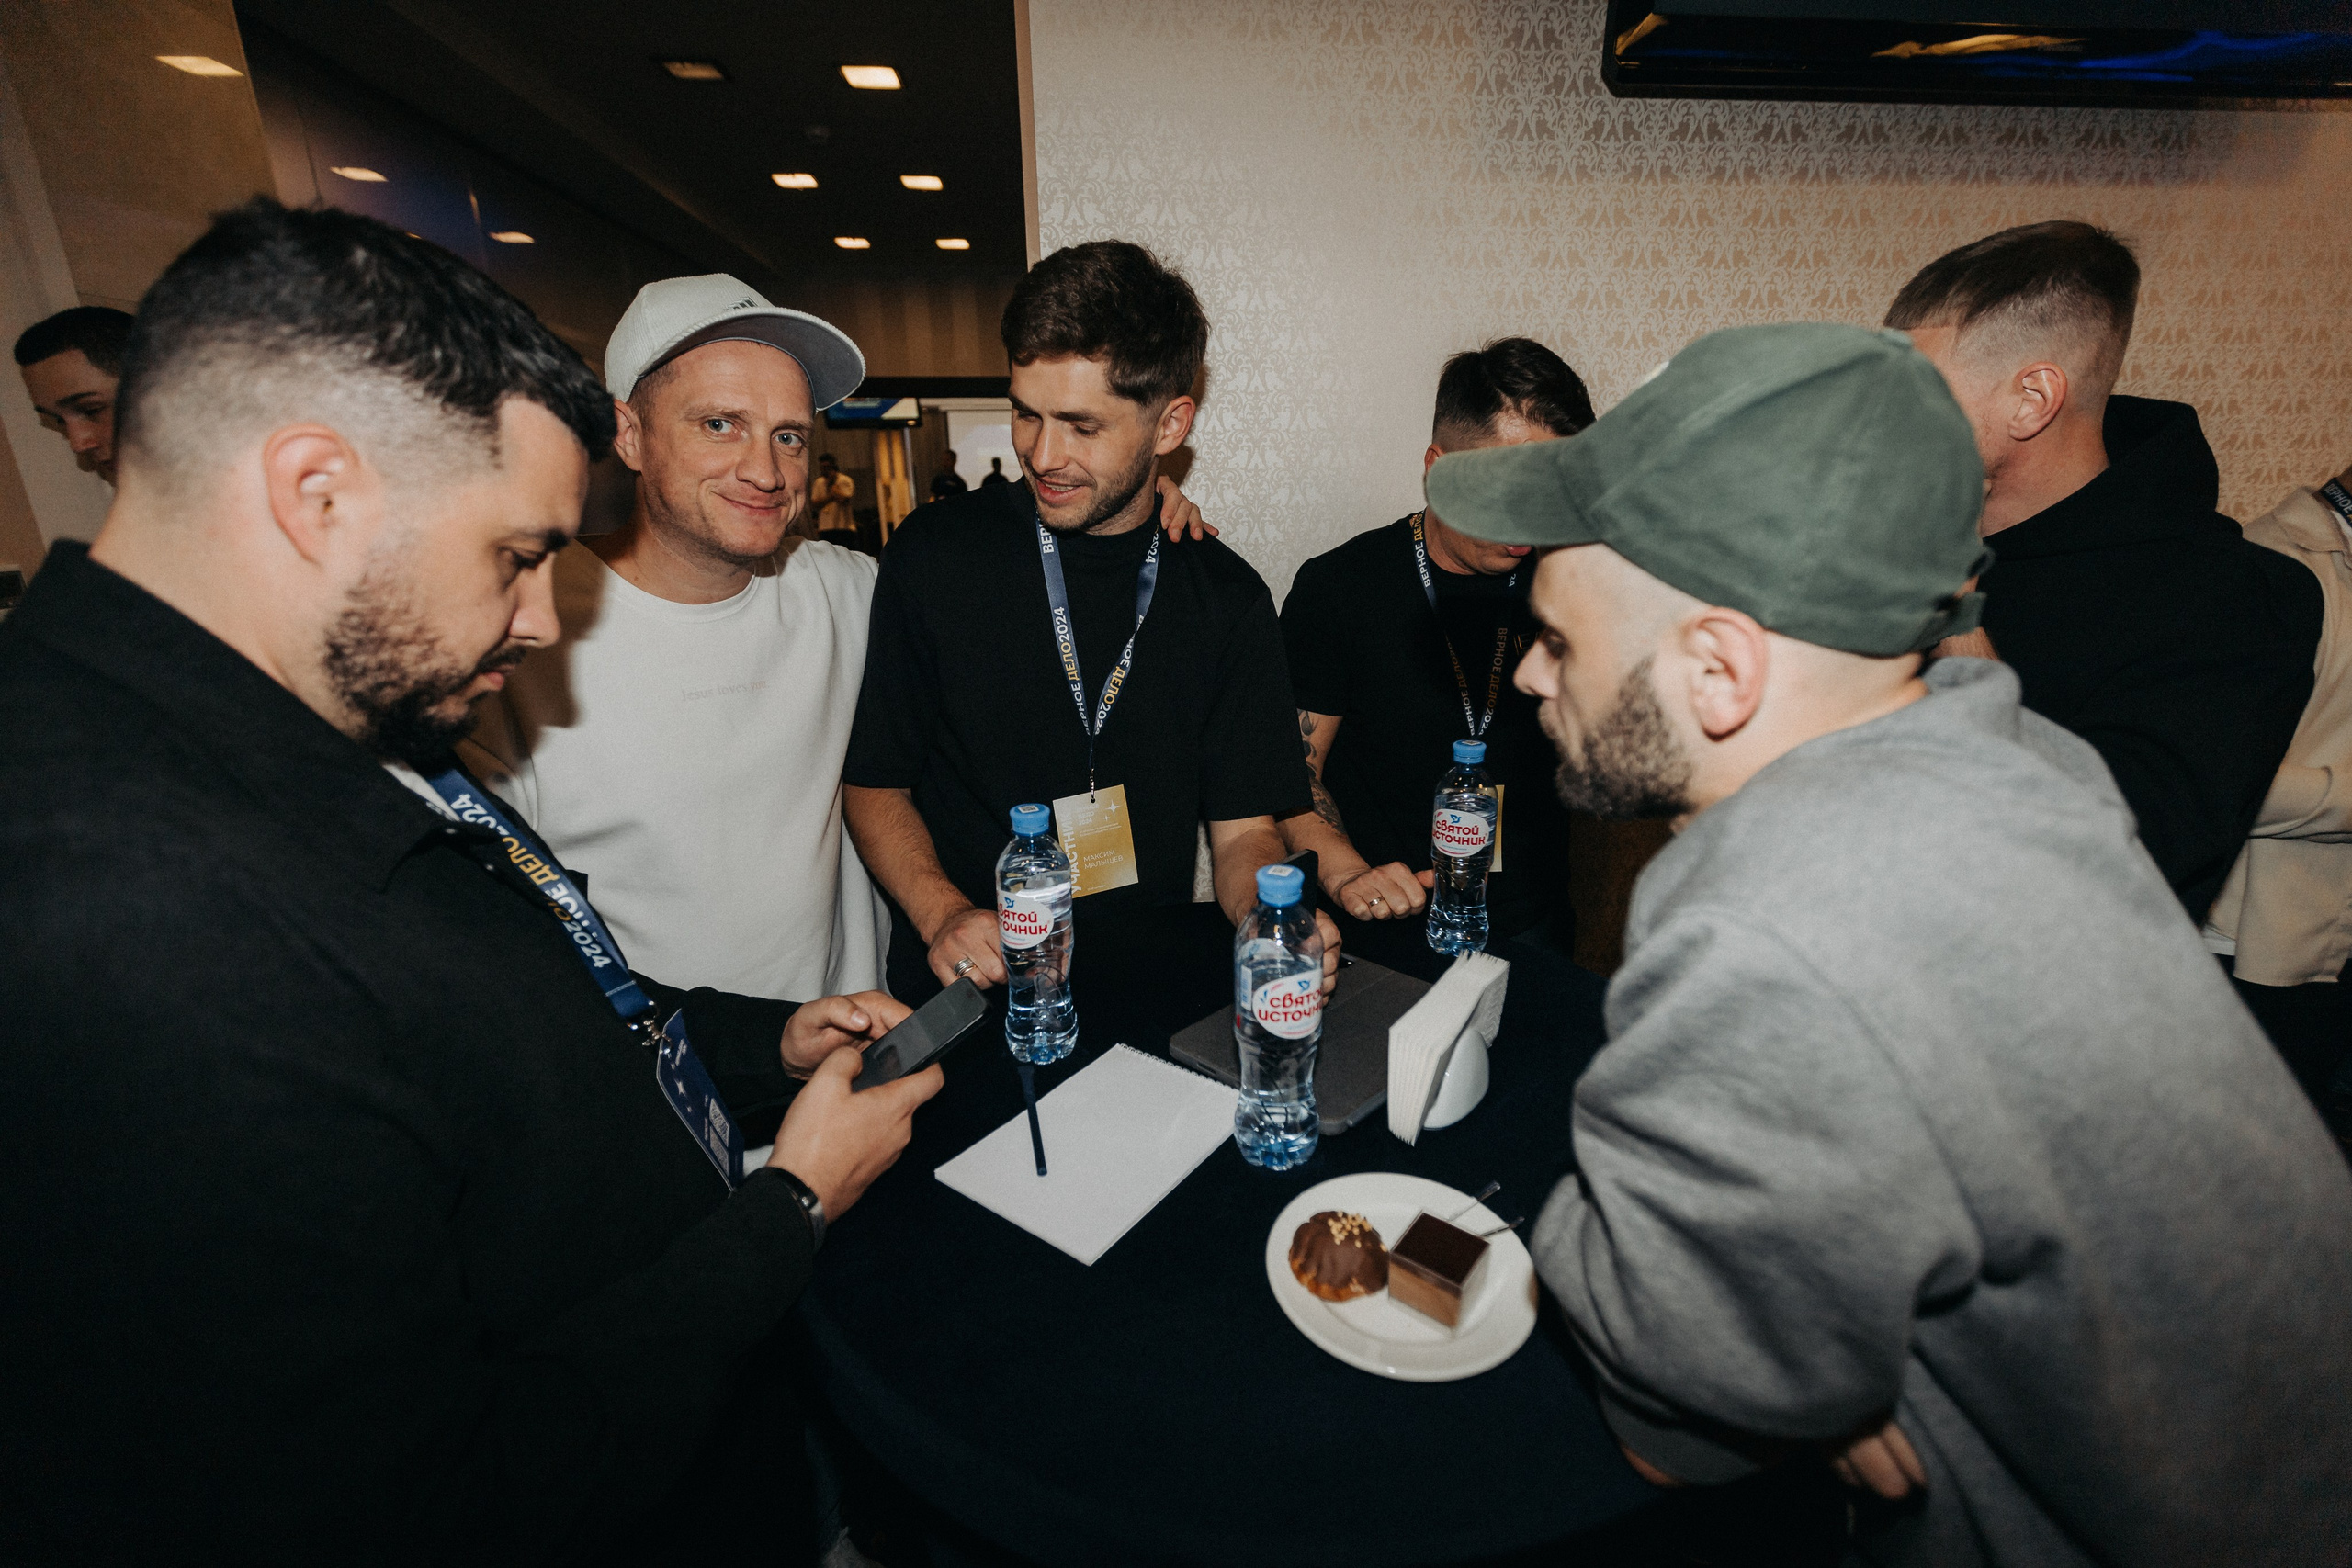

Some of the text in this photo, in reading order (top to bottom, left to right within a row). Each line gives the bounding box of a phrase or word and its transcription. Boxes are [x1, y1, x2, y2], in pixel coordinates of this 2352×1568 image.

[1413, 511, 1431, 587] ВЕРНОЕ ДЕЛО
[1054, 606, 1080, 681] ДЕЛО2024
[1120, 615, 1145, 667] ВНОЕ
[1492, 627, 1508, 673] ВЕРНОЕ
[1083, 850, 1115, 863] МАКСИМ
[1084, 854, 1124, 870] МАЛЫШЕВ
[999, 903, 1037, 924] ВЯТОЙ
[1001, 919, 1048, 935] ОЧНИК
[1270, 989, 1321, 1009] СВЯТО
[1259, 1002, 1321, 1022] ИСТОЧН
